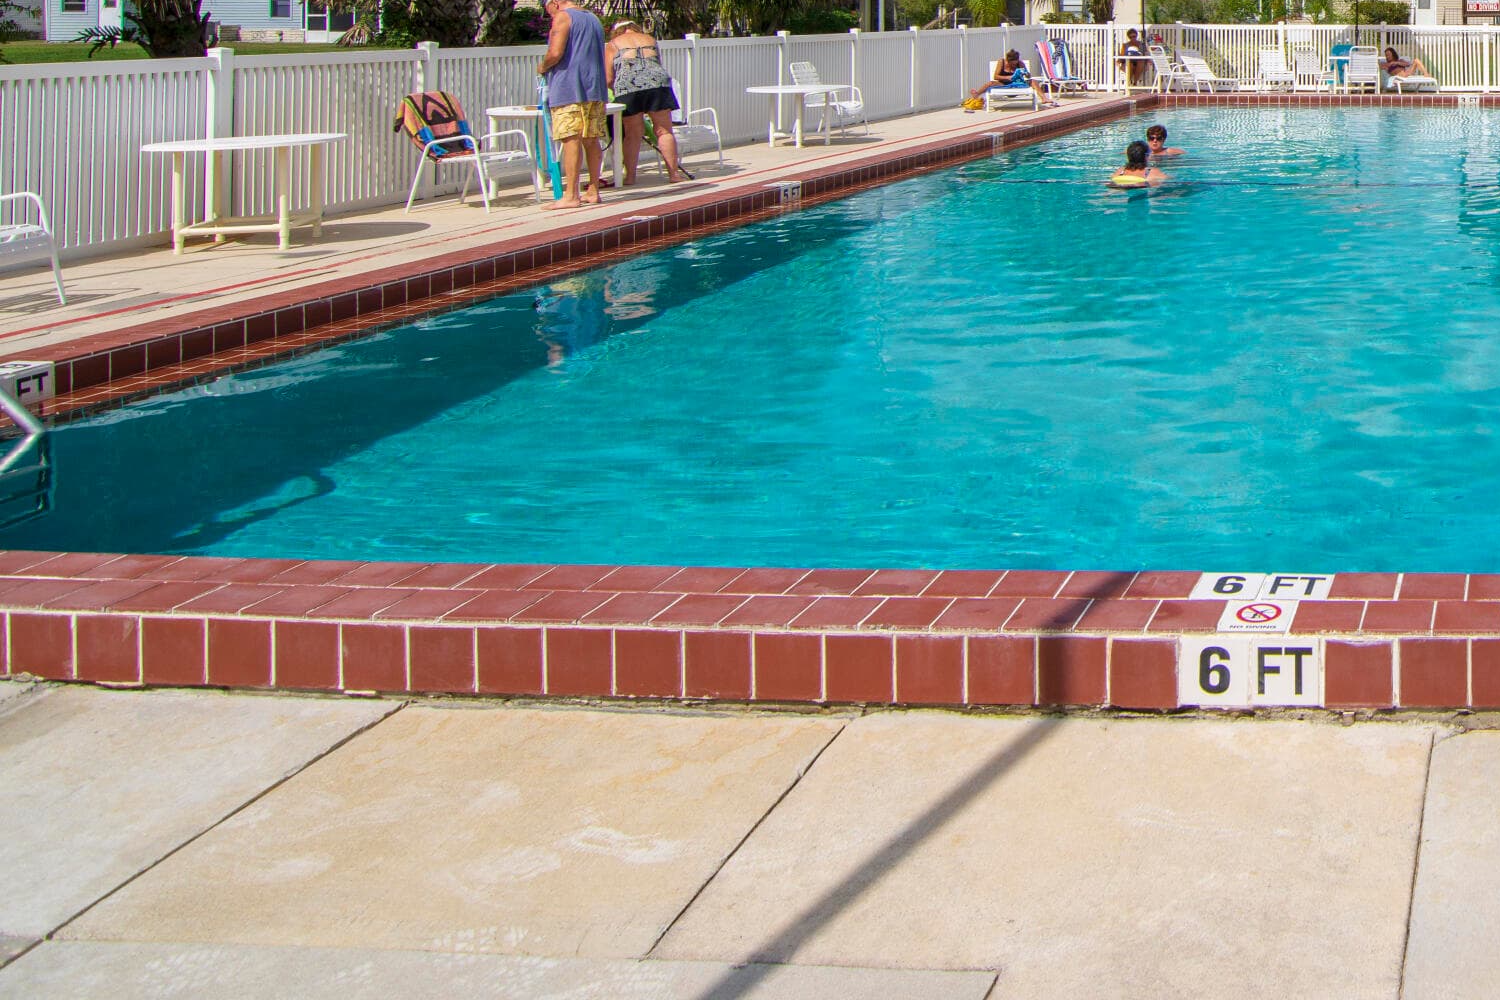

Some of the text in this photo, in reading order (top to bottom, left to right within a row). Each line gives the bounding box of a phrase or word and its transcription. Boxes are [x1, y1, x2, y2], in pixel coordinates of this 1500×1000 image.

[791, 185, 800, 199] FT
[16, 370, 48, 397] FT
[1213, 575, 1326, 595] 6 FT
[1200, 646, 1313, 695] 6 FT
